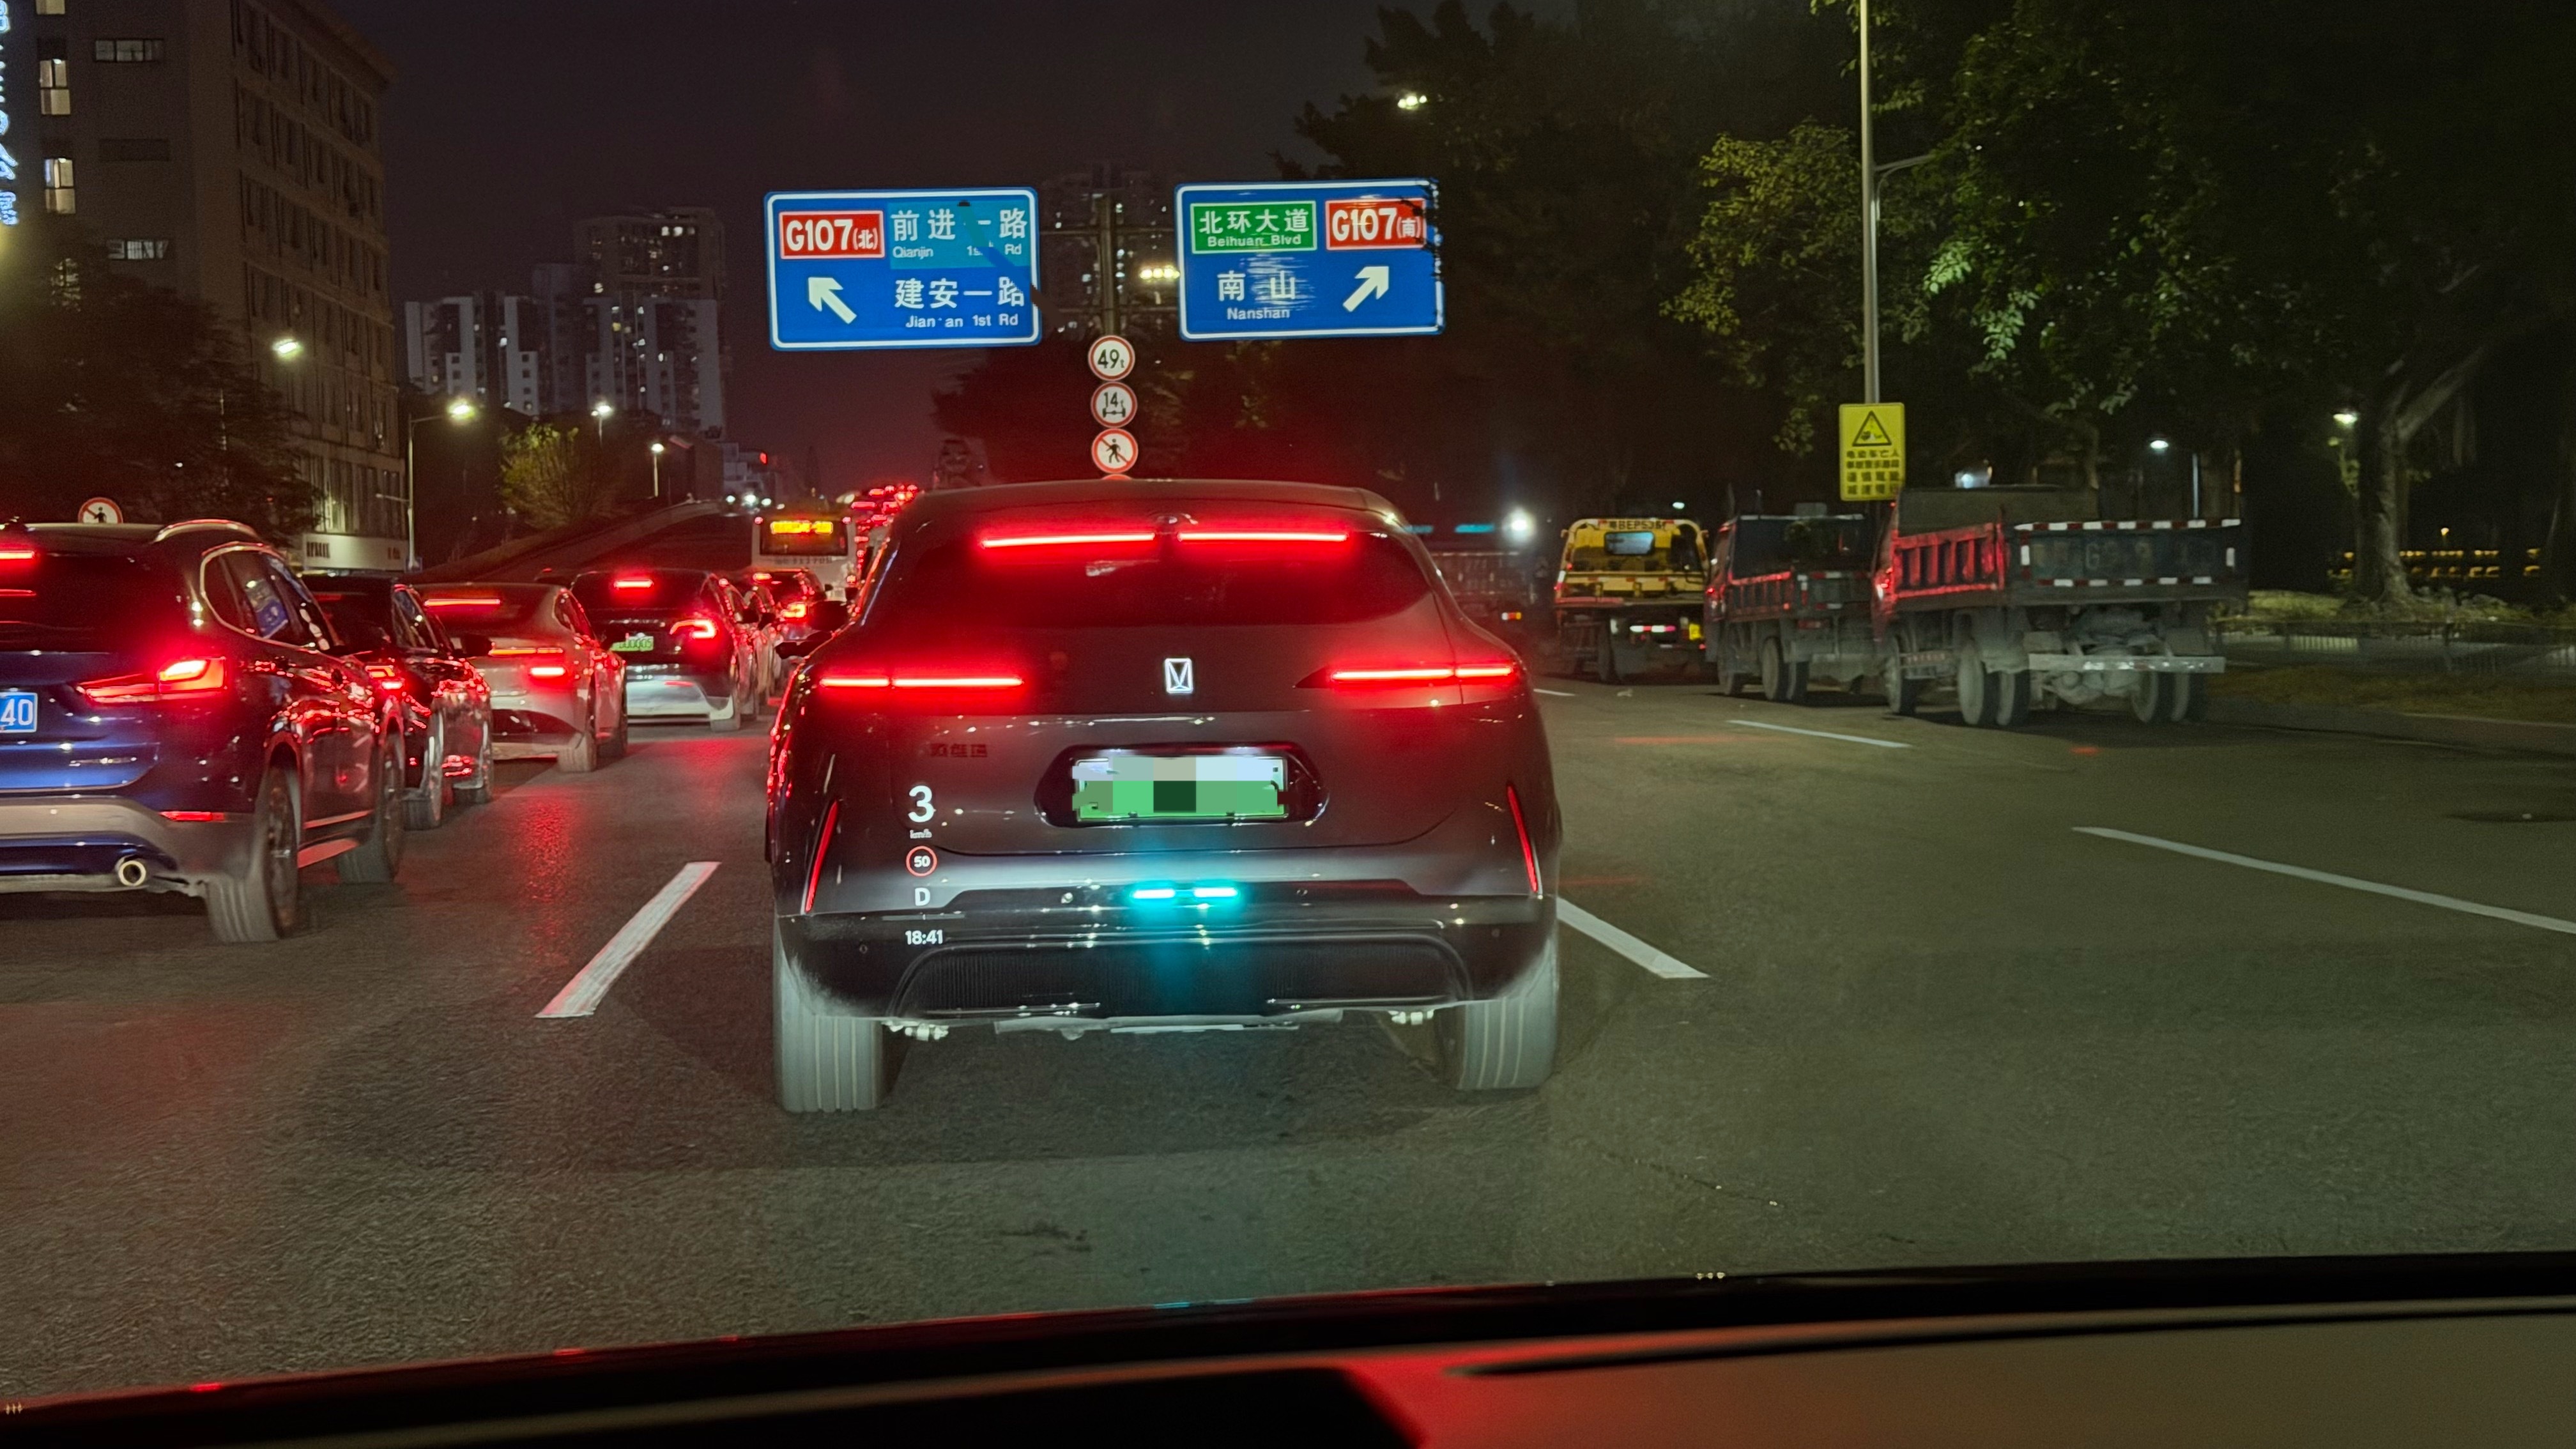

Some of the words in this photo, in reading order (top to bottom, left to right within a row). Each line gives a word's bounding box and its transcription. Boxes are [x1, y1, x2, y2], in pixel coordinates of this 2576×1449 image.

[1199, 208, 1309, 234] 北环大道
[1208, 236, 1263, 247] Beihuan
[1271, 234, 1301, 245] Blvd
[893, 246, 933, 260] Qianjin
[1004, 243, 1022, 255] Rd
[894, 277, 1025, 309] 建安一路
[1217, 270, 1296, 301] 南山
[972, 314, 992, 326] 1st
[999, 313, 1018, 326] Rd
[1227, 307, 1290, 320] Nanshan
[908, 785, 934, 823] 3
[914, 855, 931, 868] 50
[914, 887, 931, 906] D
[905, 930, 943, 945] 18:41
